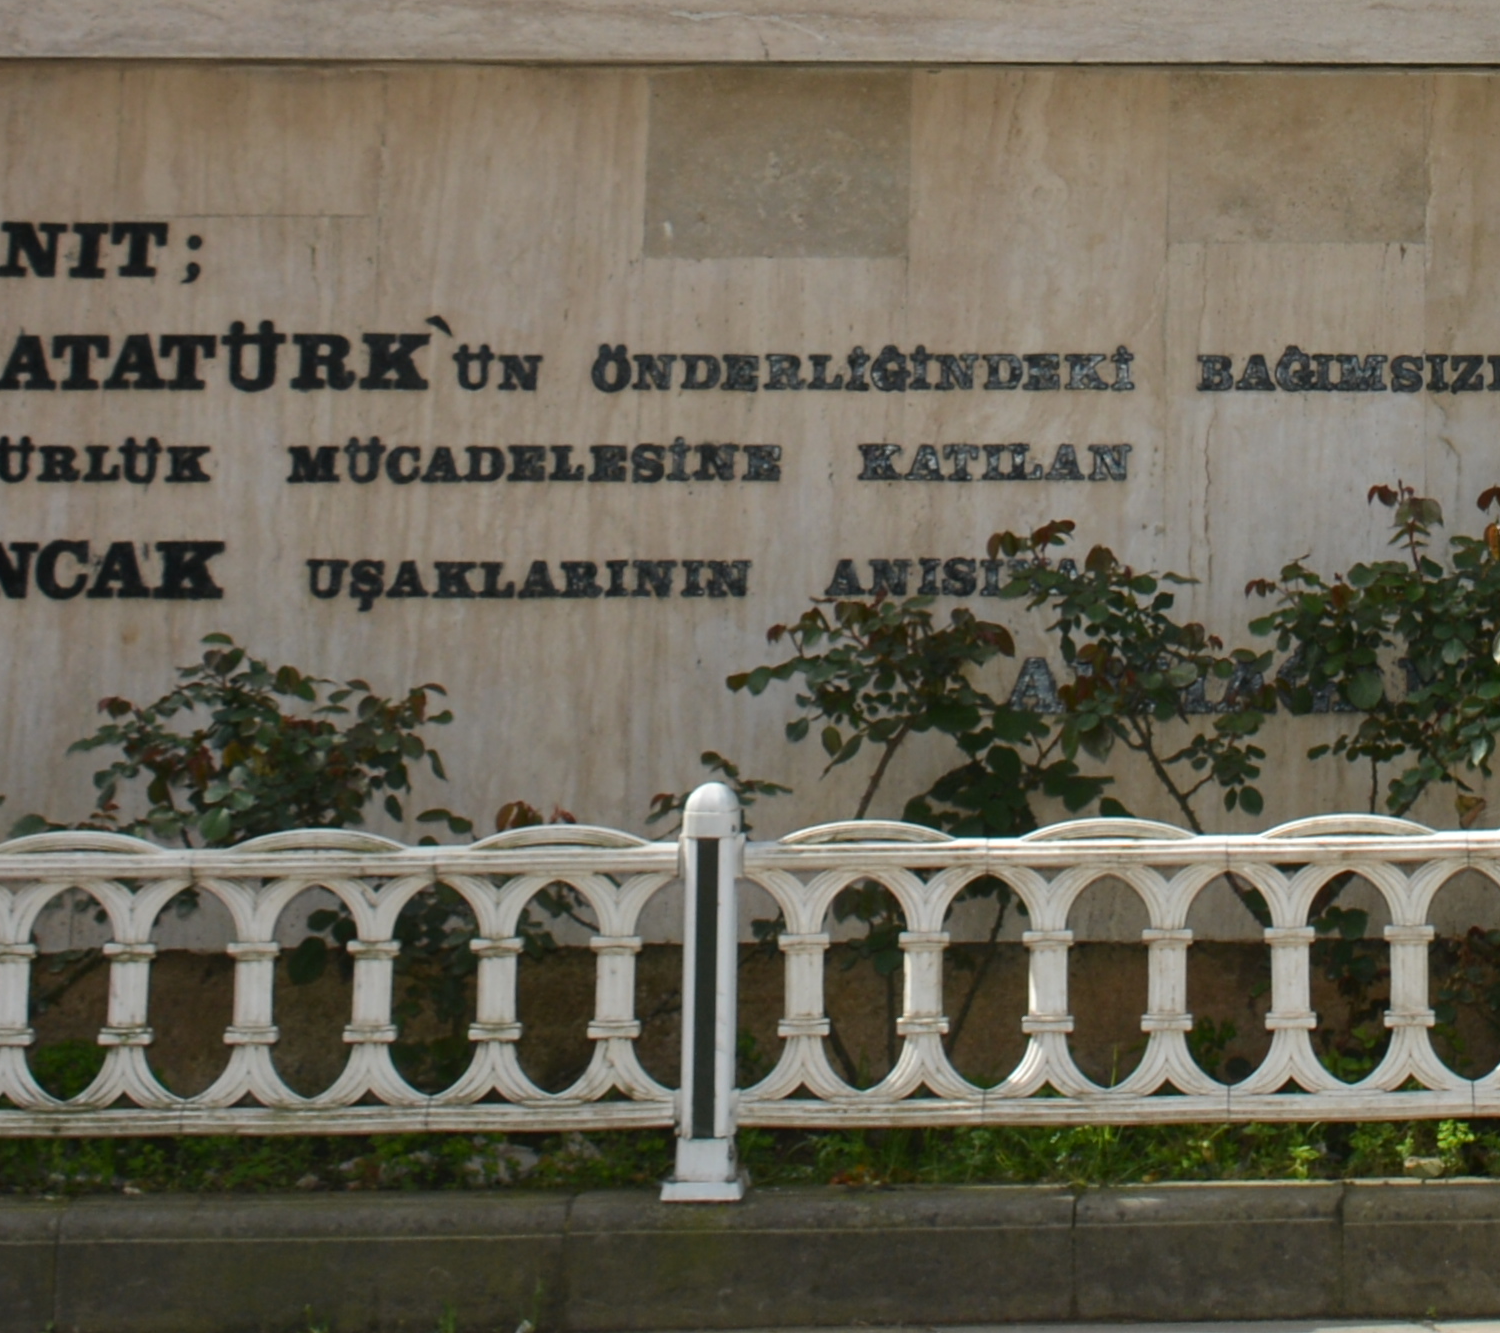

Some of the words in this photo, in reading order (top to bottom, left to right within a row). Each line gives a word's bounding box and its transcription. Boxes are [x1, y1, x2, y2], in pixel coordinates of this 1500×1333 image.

[591, 343, 1136, 394] ÖNDERLİĞİNDEKİ
[286, 434, 783, 484] MÜCADELESİNE
[858, 441, 1134, 483] KATILAN
[305, 558, 752, 612] UŞAKLARININ
